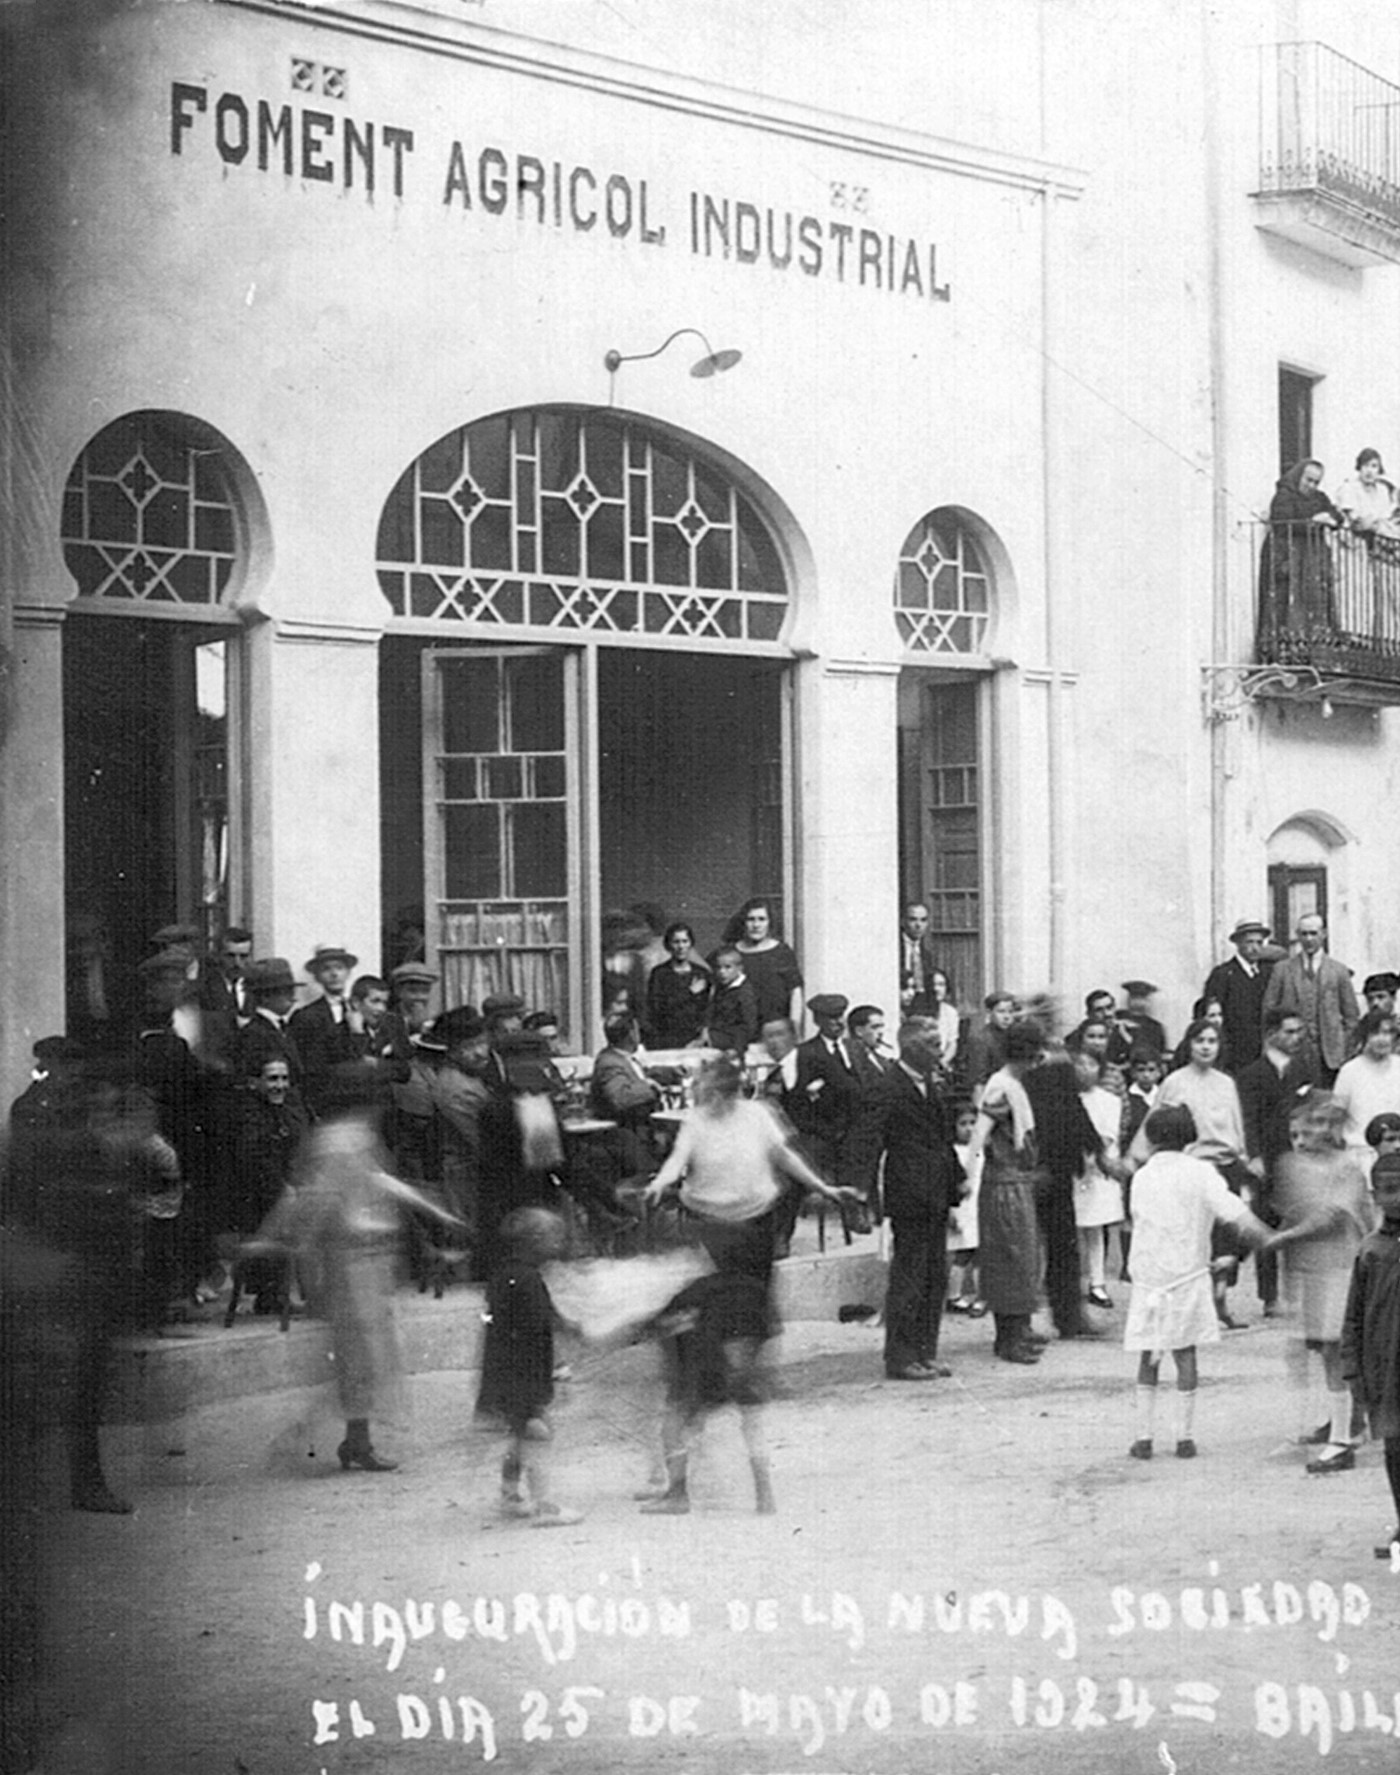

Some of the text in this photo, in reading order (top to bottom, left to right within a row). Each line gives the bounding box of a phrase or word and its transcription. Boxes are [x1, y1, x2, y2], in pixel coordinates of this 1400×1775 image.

[170, 82, 952, 303] FOMENT AGRICOL INDUSTRIAL
